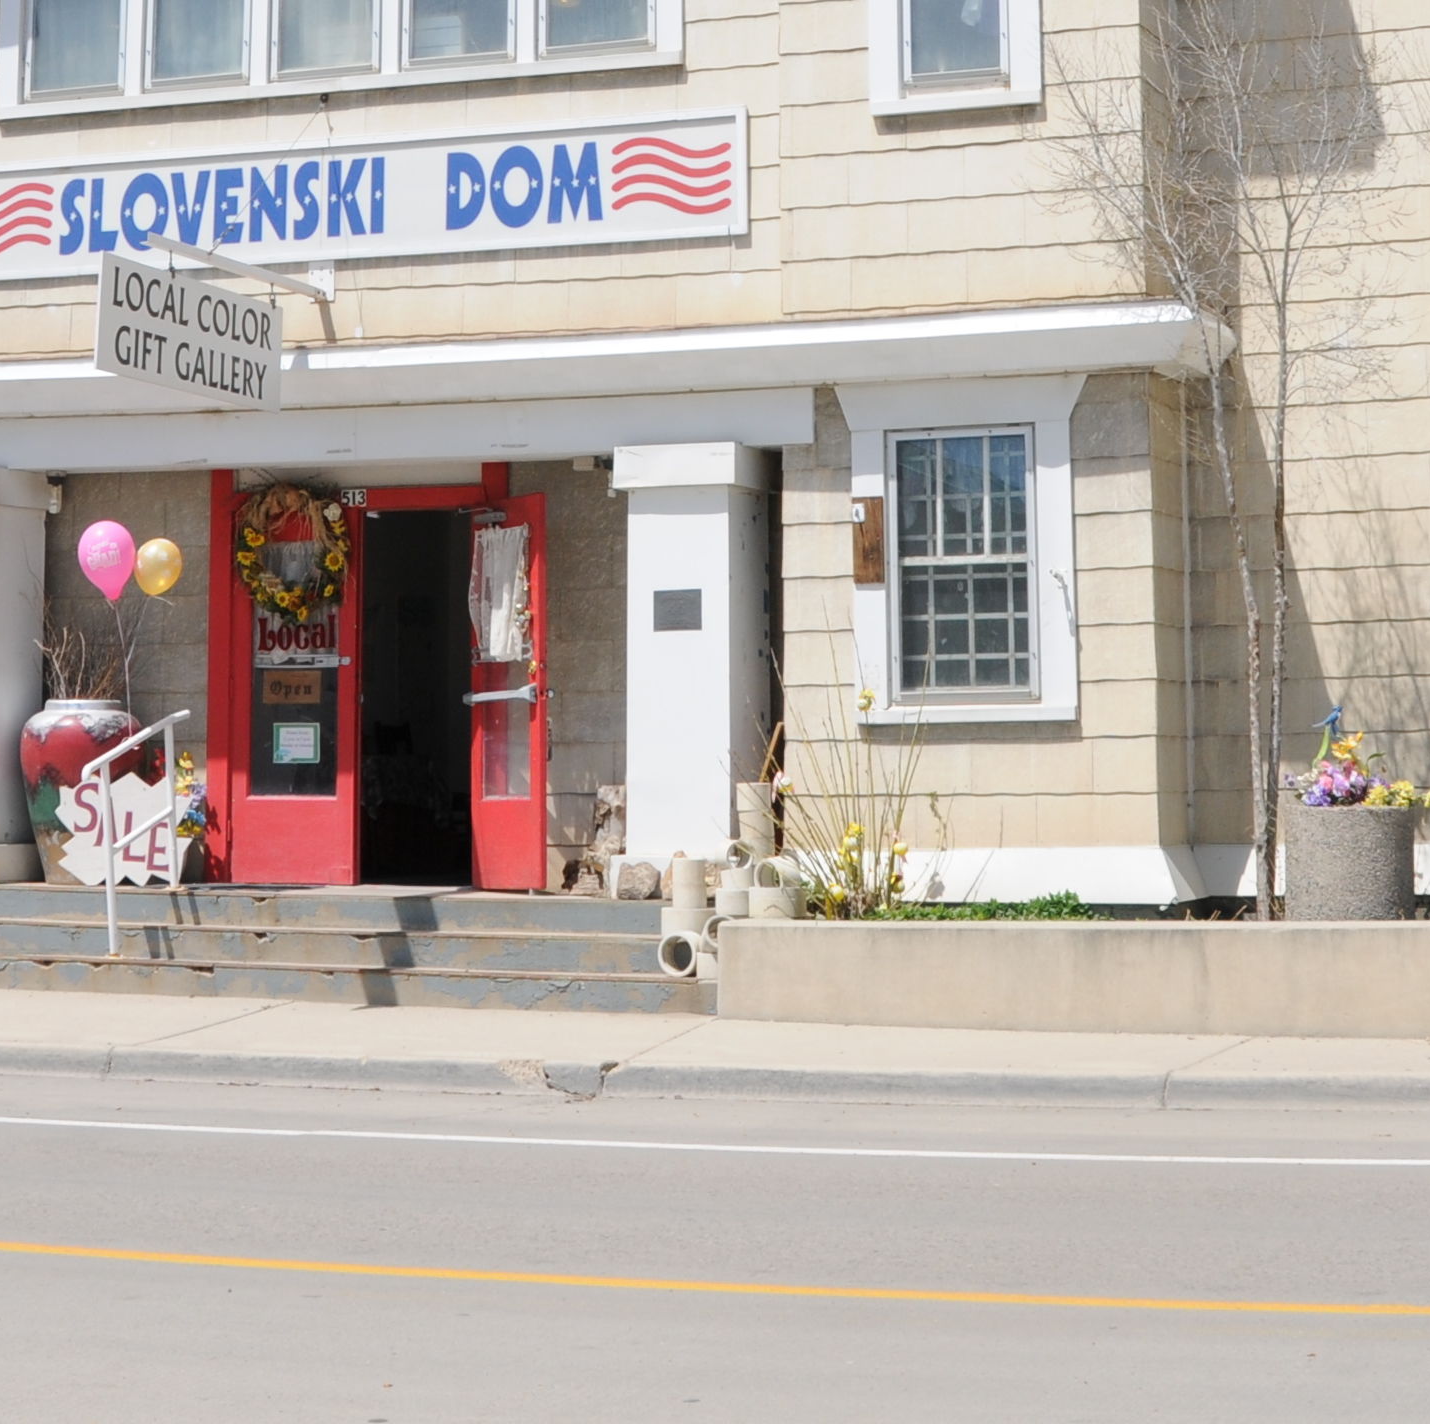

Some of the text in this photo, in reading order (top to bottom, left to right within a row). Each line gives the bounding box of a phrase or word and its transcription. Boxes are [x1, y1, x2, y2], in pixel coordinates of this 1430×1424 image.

[59, 141, 604, 256] SLOVENSKI DOM
[112, 266, 272, 351] LOCAL COLOR
[114, 325, 268, 400] GIFT GALLERY
[342, 490, 366, 506] 513
[257, 614, 336, 652] Local
[269, 680, 313, 699] Open
